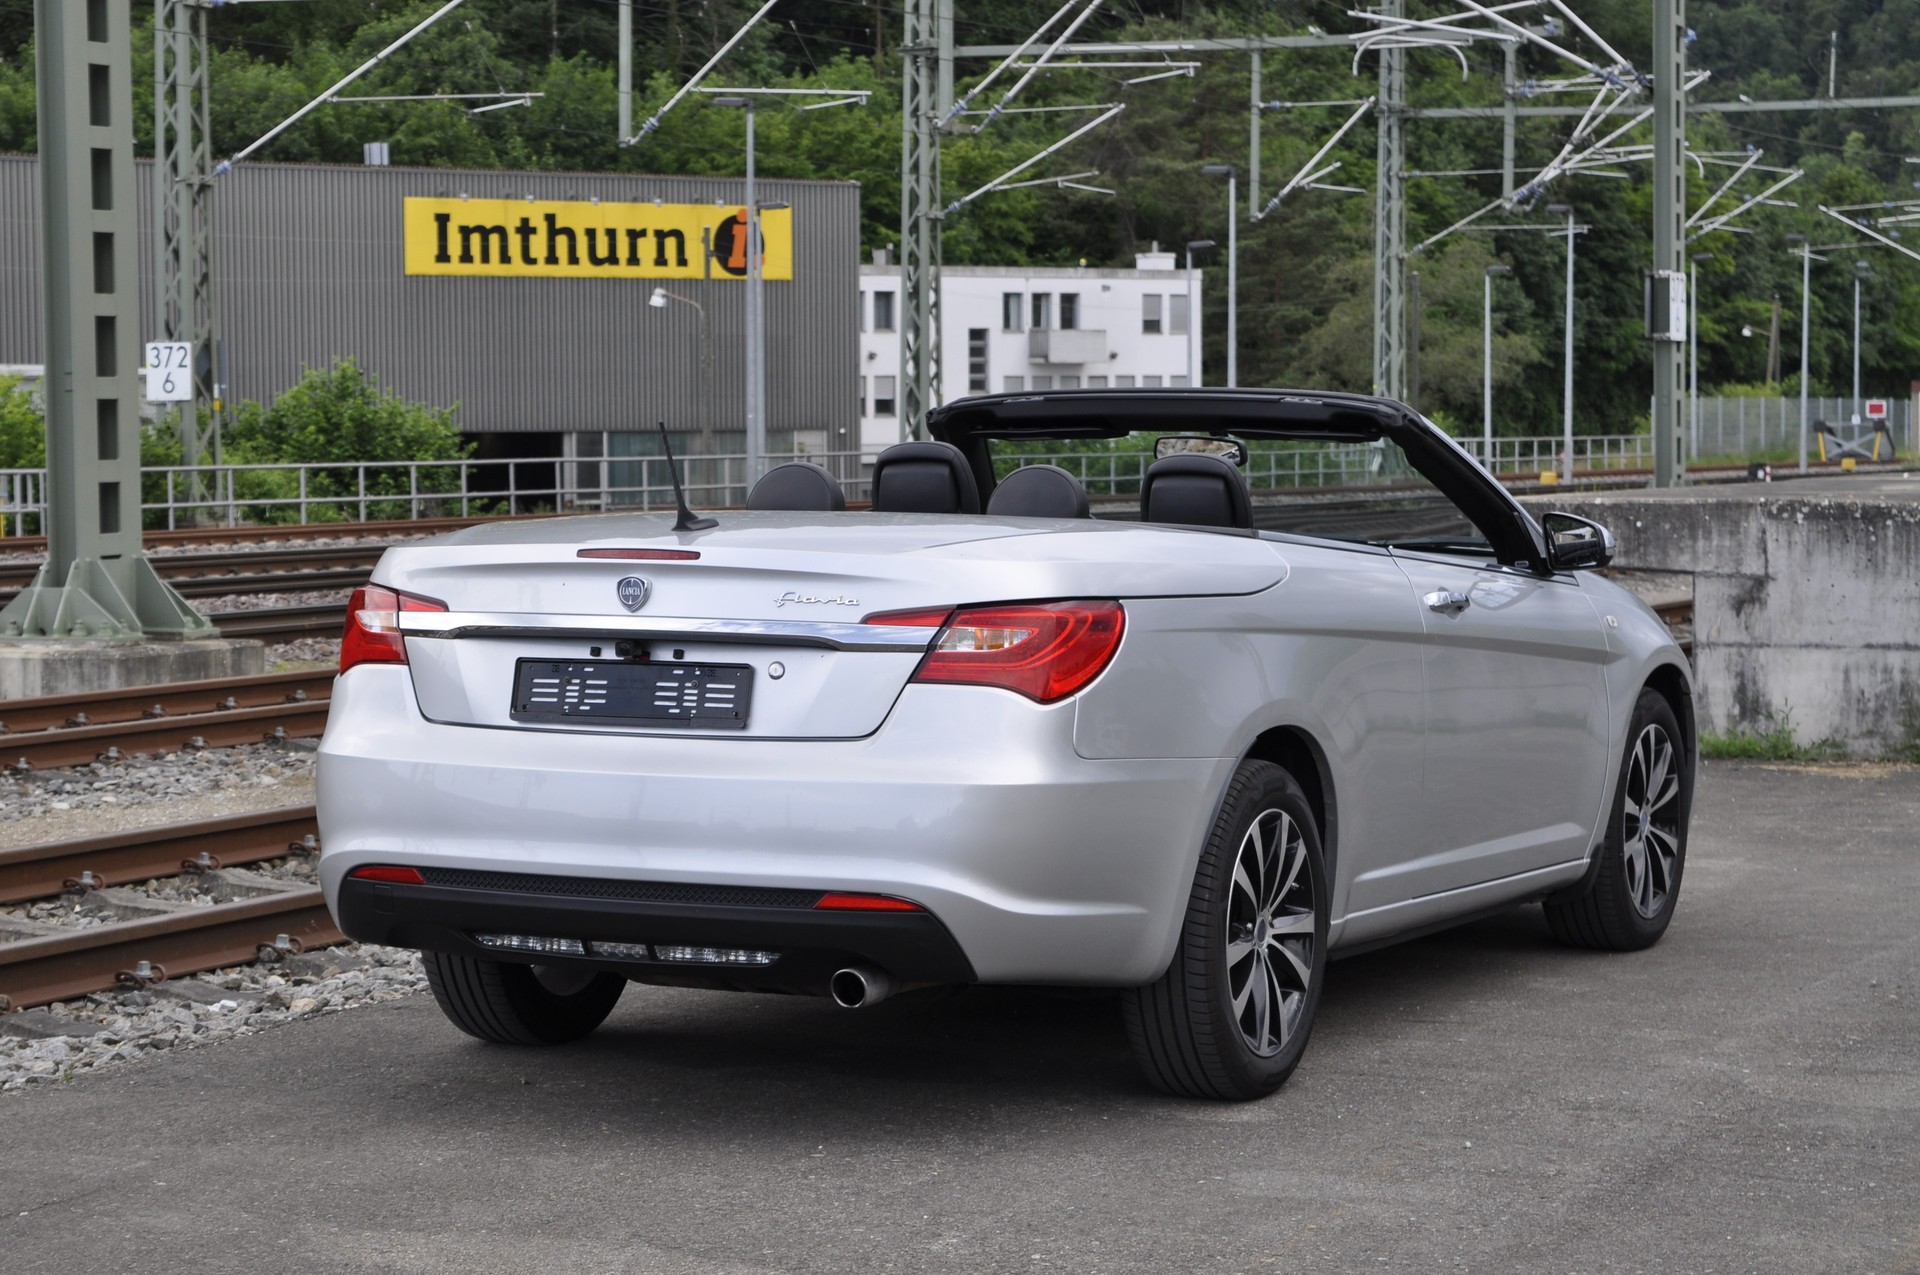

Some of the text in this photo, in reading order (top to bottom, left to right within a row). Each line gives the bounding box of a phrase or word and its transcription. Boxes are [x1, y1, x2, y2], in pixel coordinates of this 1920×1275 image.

[434, 213, 688, 267] Imthurn
[150, 346, 187, 368] 372
[163, 372, 175, 394] 6
[622, 587, 641, 595] LANCIA
